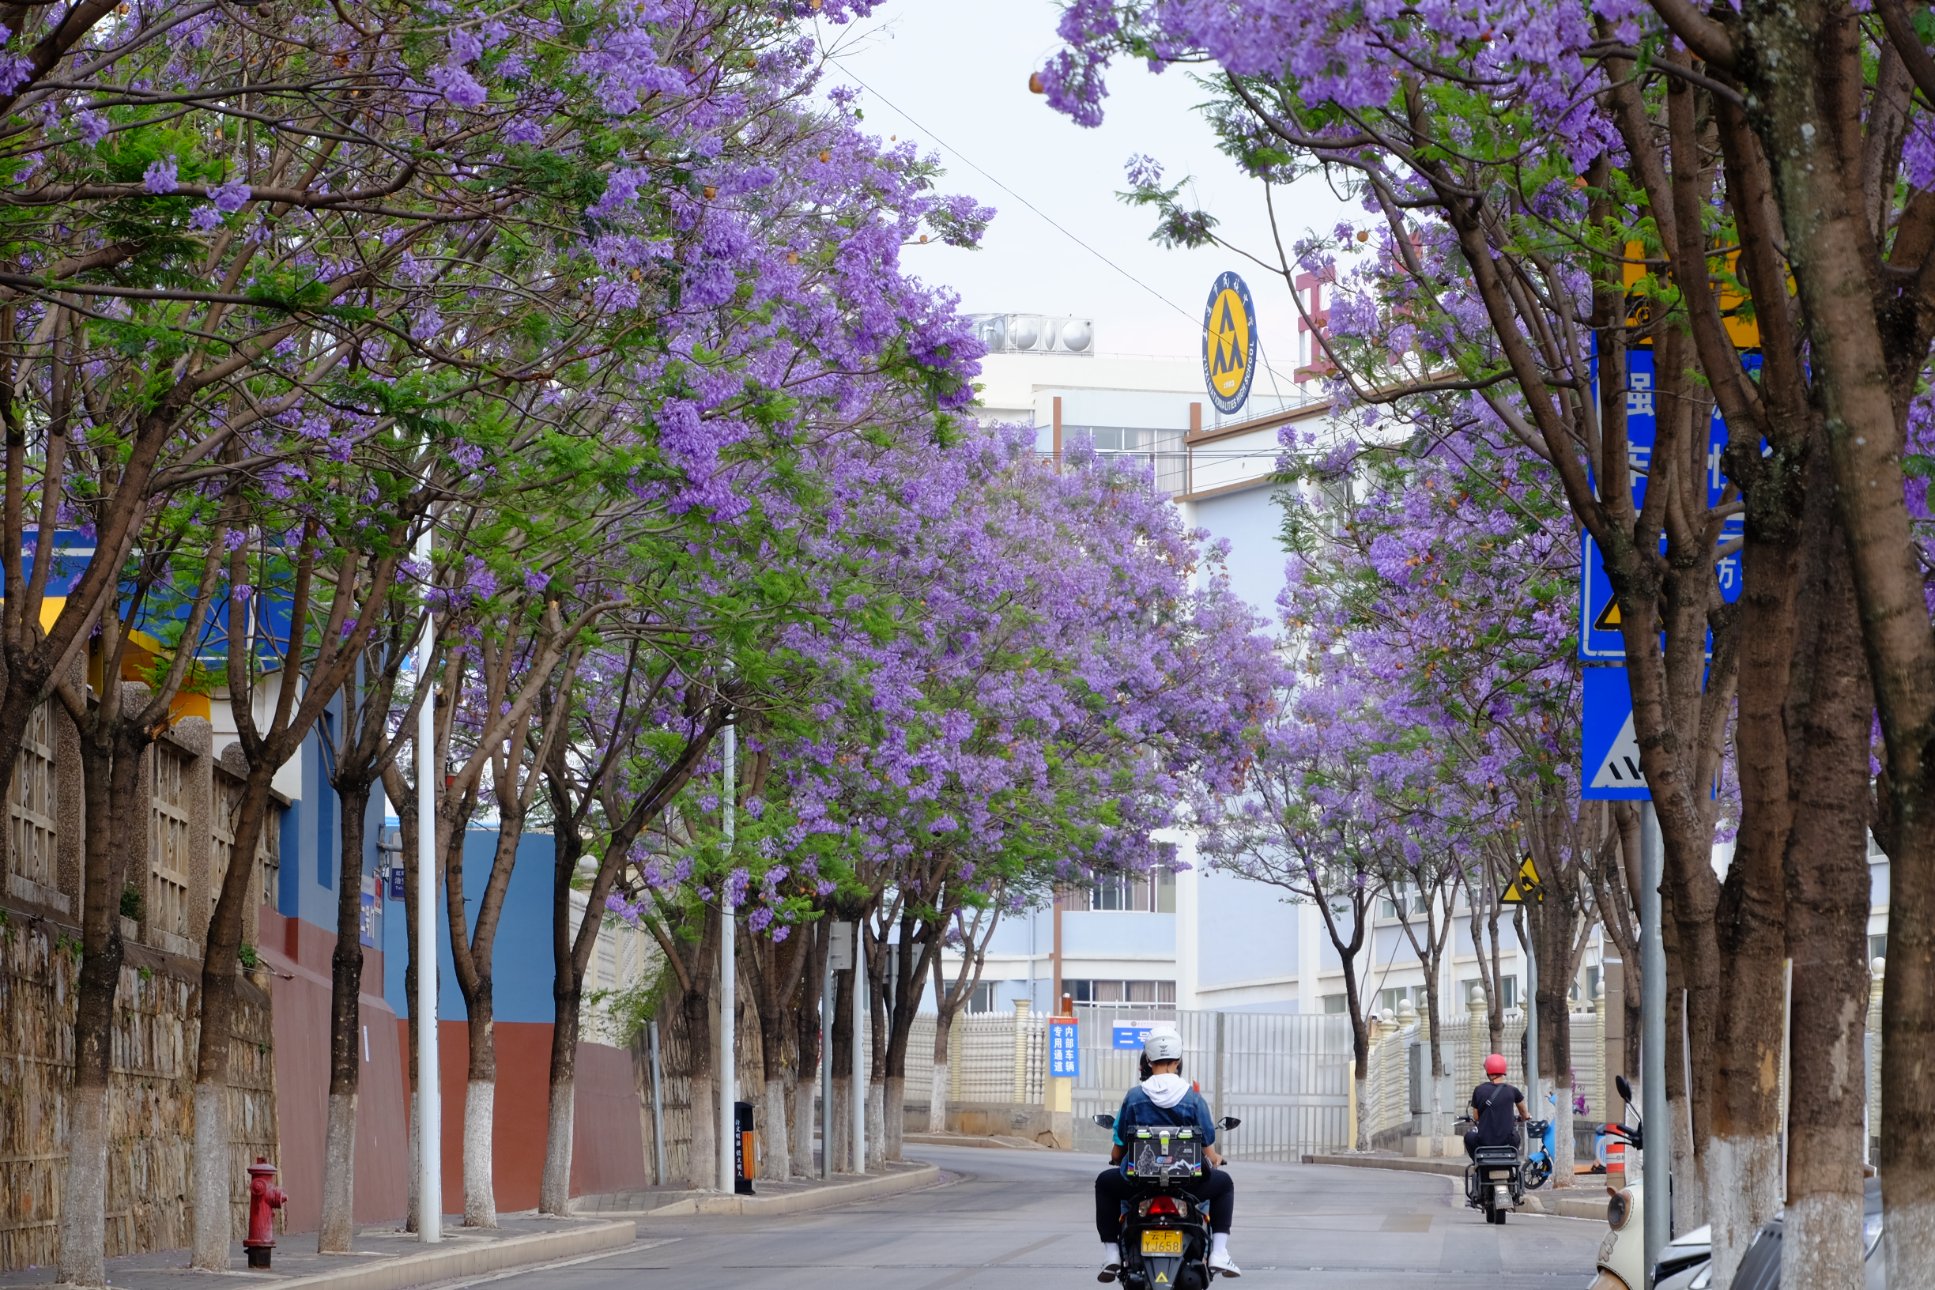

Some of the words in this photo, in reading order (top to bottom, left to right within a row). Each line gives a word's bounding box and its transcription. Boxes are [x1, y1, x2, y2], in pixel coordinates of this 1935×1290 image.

[1208, 382, 1237, 411] NATIONALITIES
[1236, 383, 1247, 404] HIGH
[1244, 341, 1254, 386] SCHOOL
[1053, 1026, 1063, 1072] 专用通道
[1065, 1026, 1075, 1072] 内部车辆
[1145, 1240, 1179, 1252] YJ658
